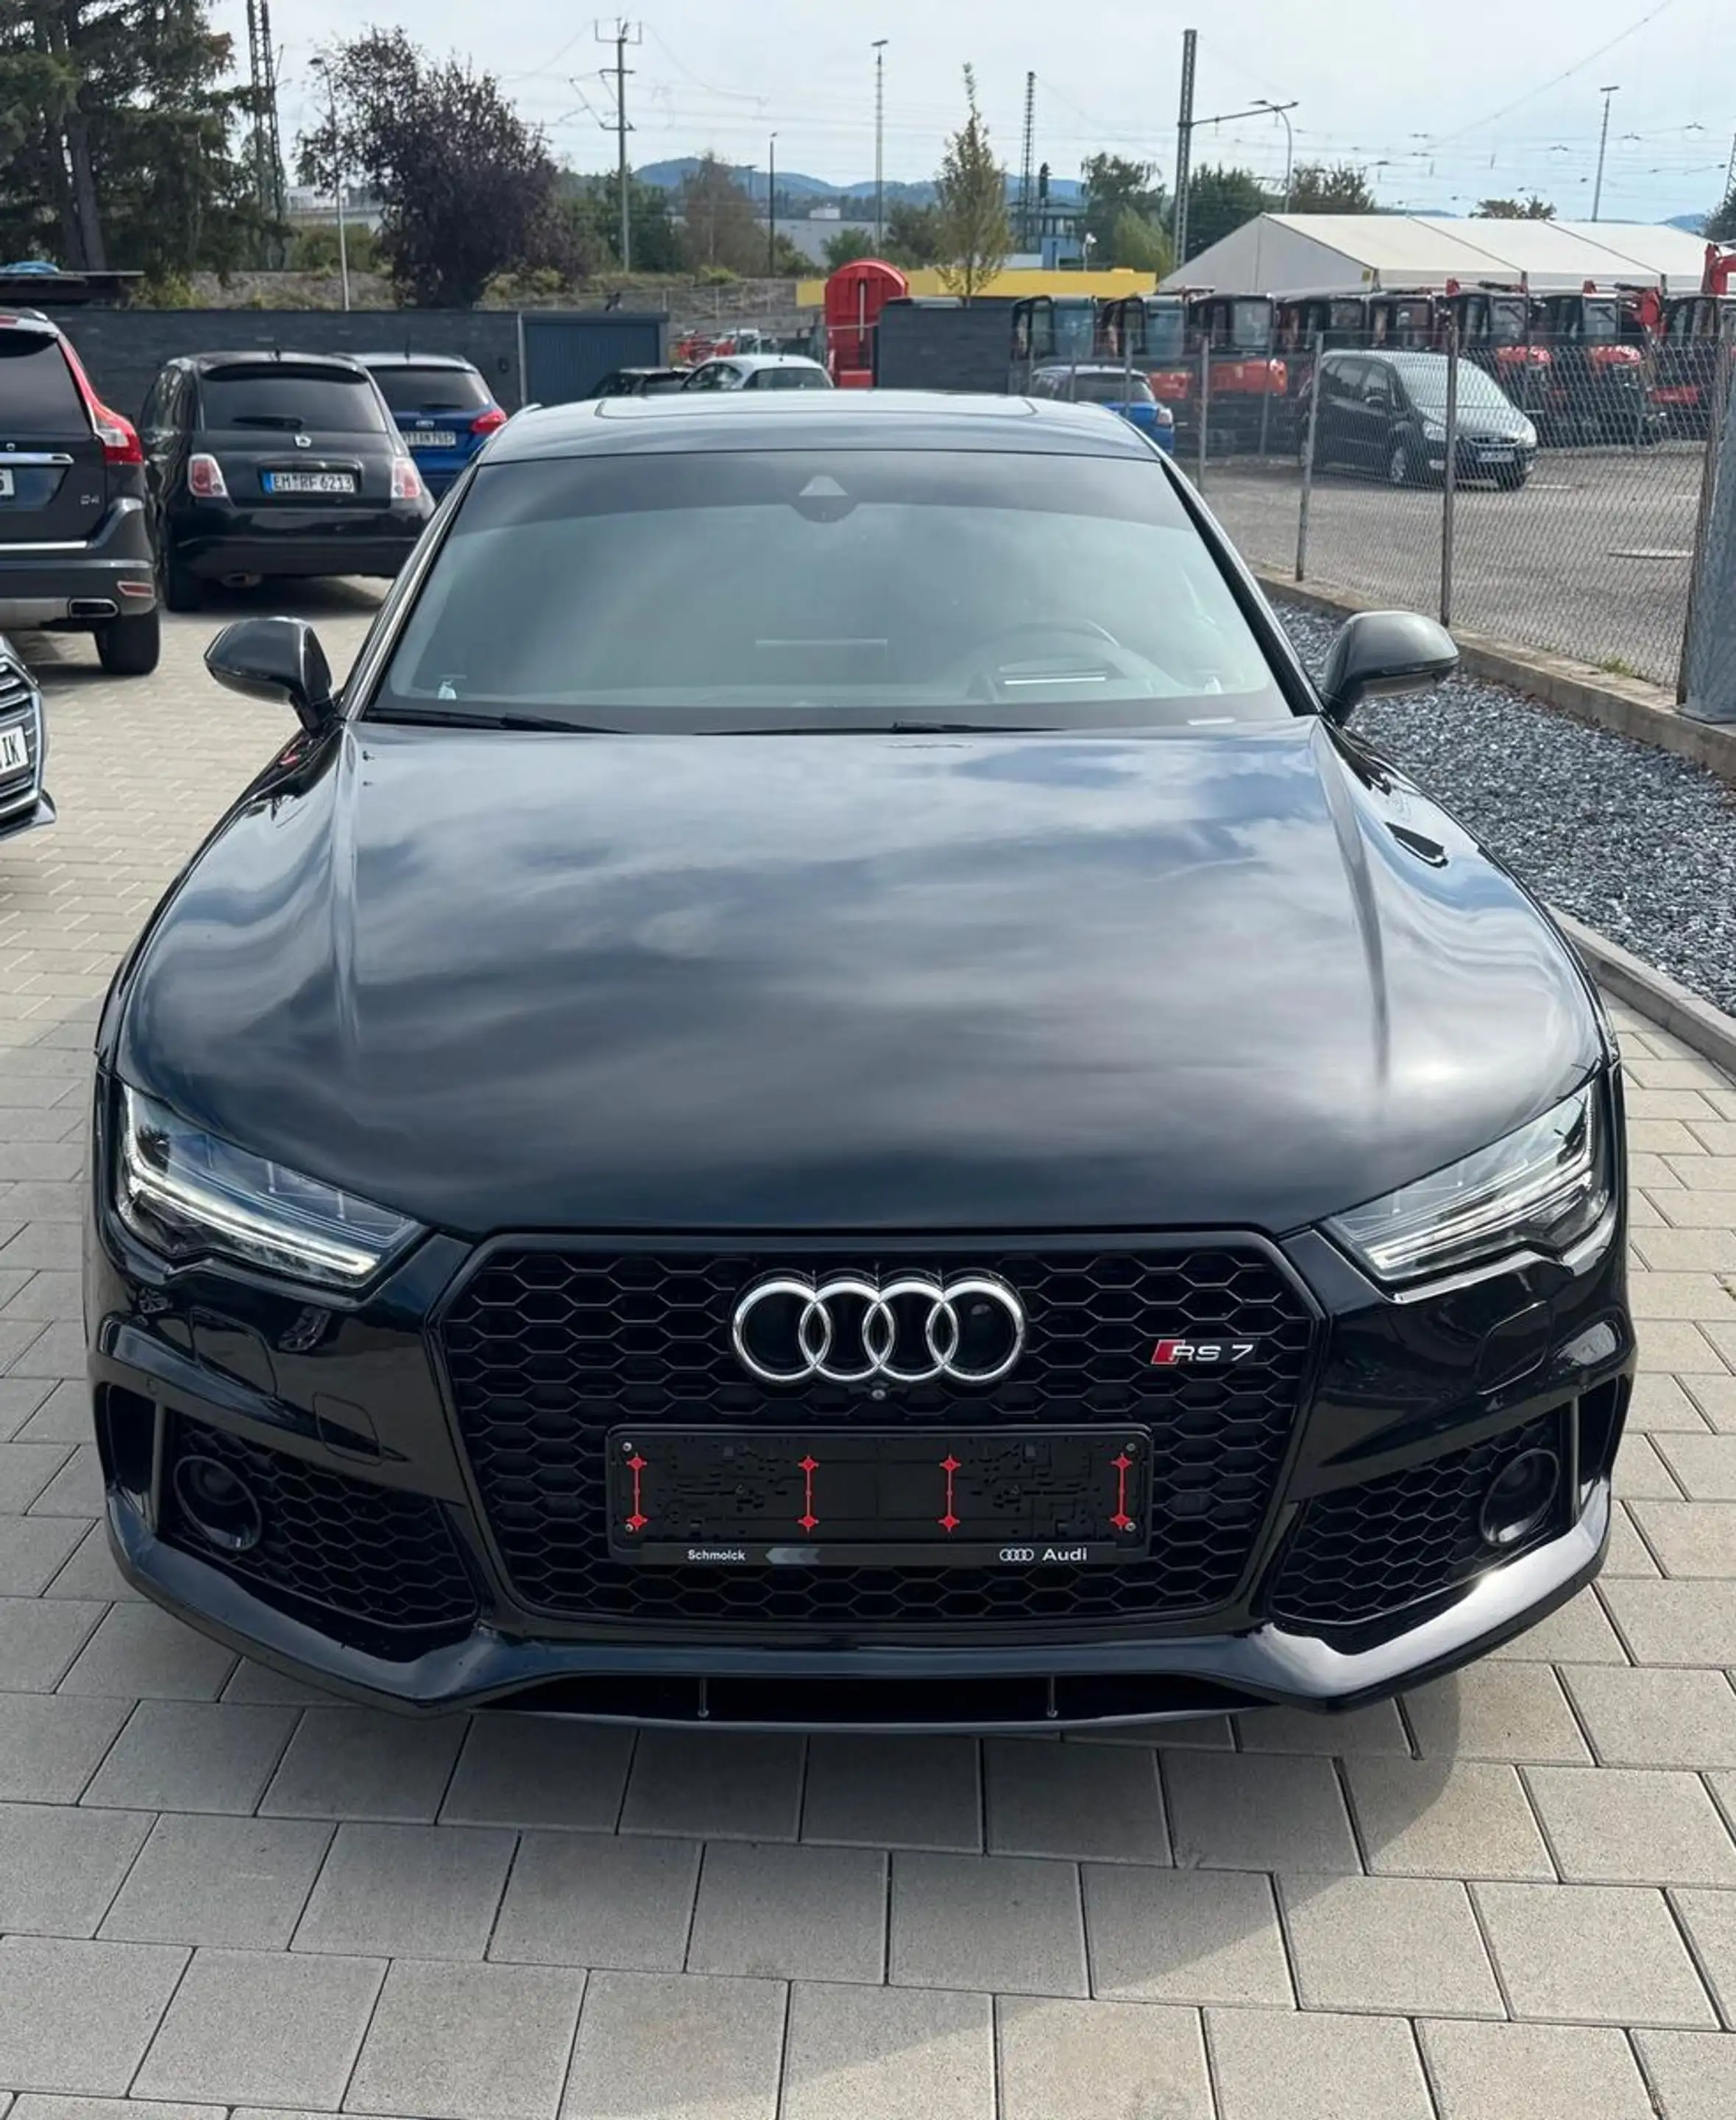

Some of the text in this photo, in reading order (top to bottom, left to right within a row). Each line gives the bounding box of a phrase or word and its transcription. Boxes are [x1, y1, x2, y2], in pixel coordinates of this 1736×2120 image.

[1168, 1344, 1254, 1362] RS 7
[687, 1549, 746, 1561] Schmolck
[1042, 1547, 1087, 1561] Audi
